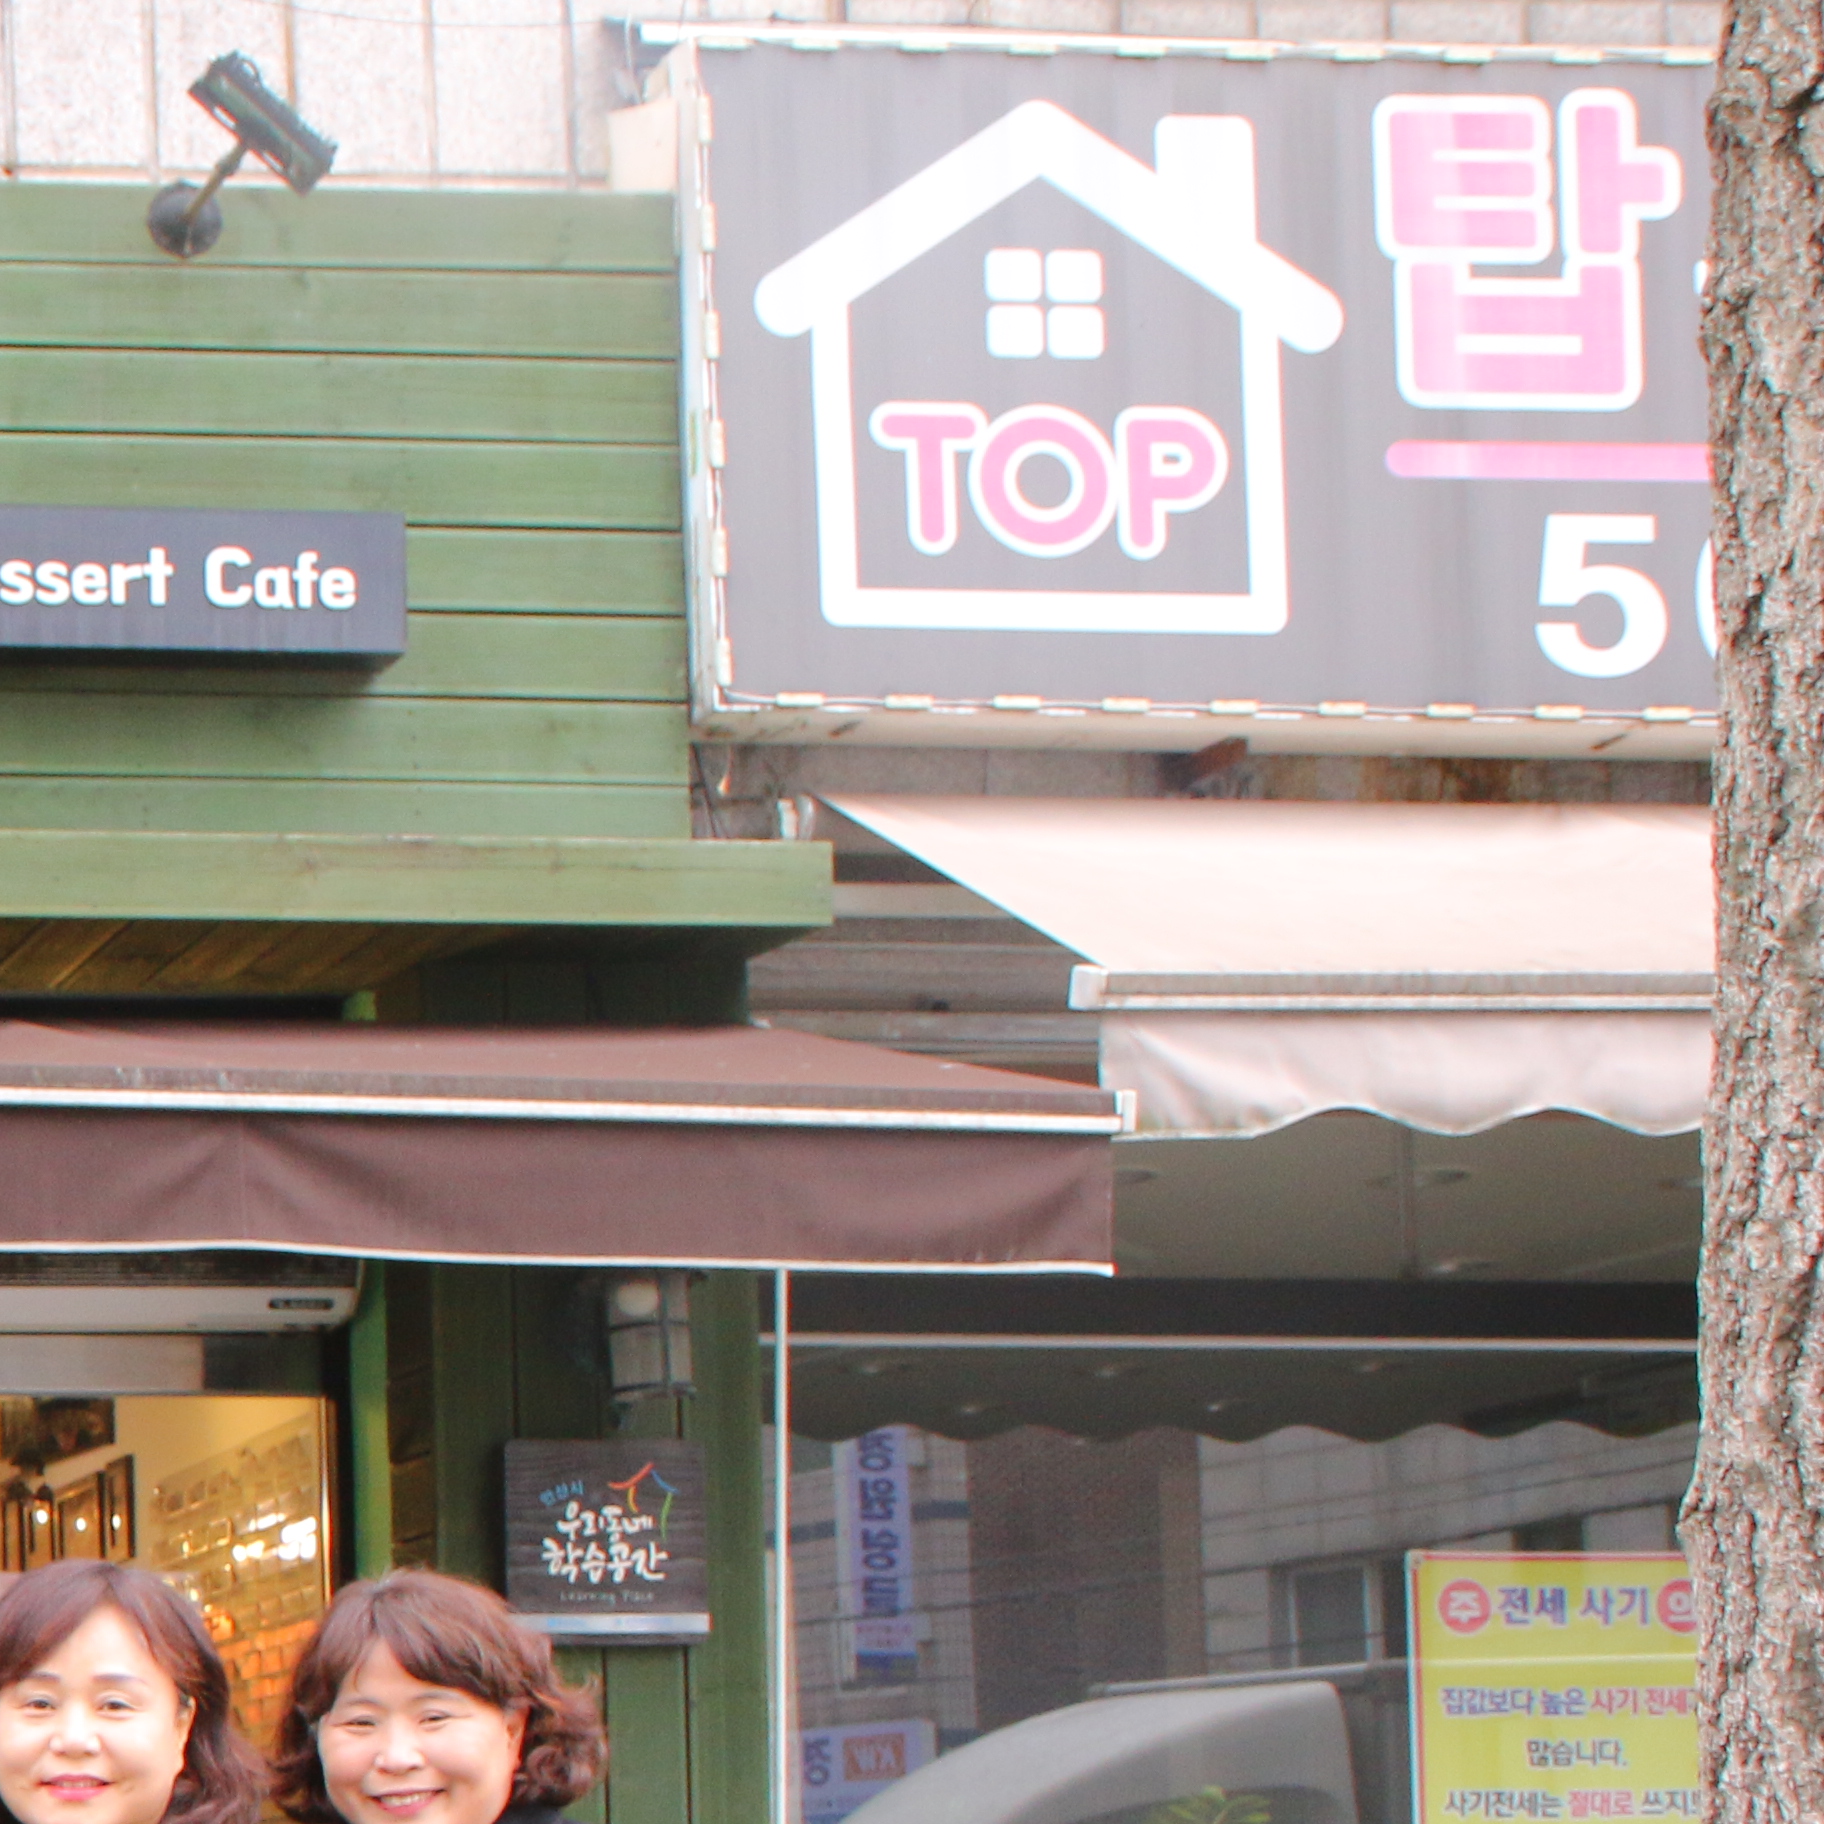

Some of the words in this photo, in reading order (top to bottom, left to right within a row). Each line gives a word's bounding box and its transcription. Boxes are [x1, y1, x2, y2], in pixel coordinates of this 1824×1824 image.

[869, 402, 1228, 560] TOP
[203, 544, 358, 612] Cafe
[555, 1500, 655, 1543] 우리동네
[542, 1536, 670, 1585] 학습공간
[1496, 1586, 1568, 1626] 전세
[1579, 1586, 1651, 1626] 사기
[1440, 1687, 1534, 1716] 집값보다
[1539, 1687, 1586, 1716] 높은
[1590, 1688, 1639, 1716] 사기
[1526, 1739, 1629, 1768] 많습니다.
[1444, 1789, 1564, 1819] 사기전세는
[1567, 1789, 1635, 1817] 절대로
